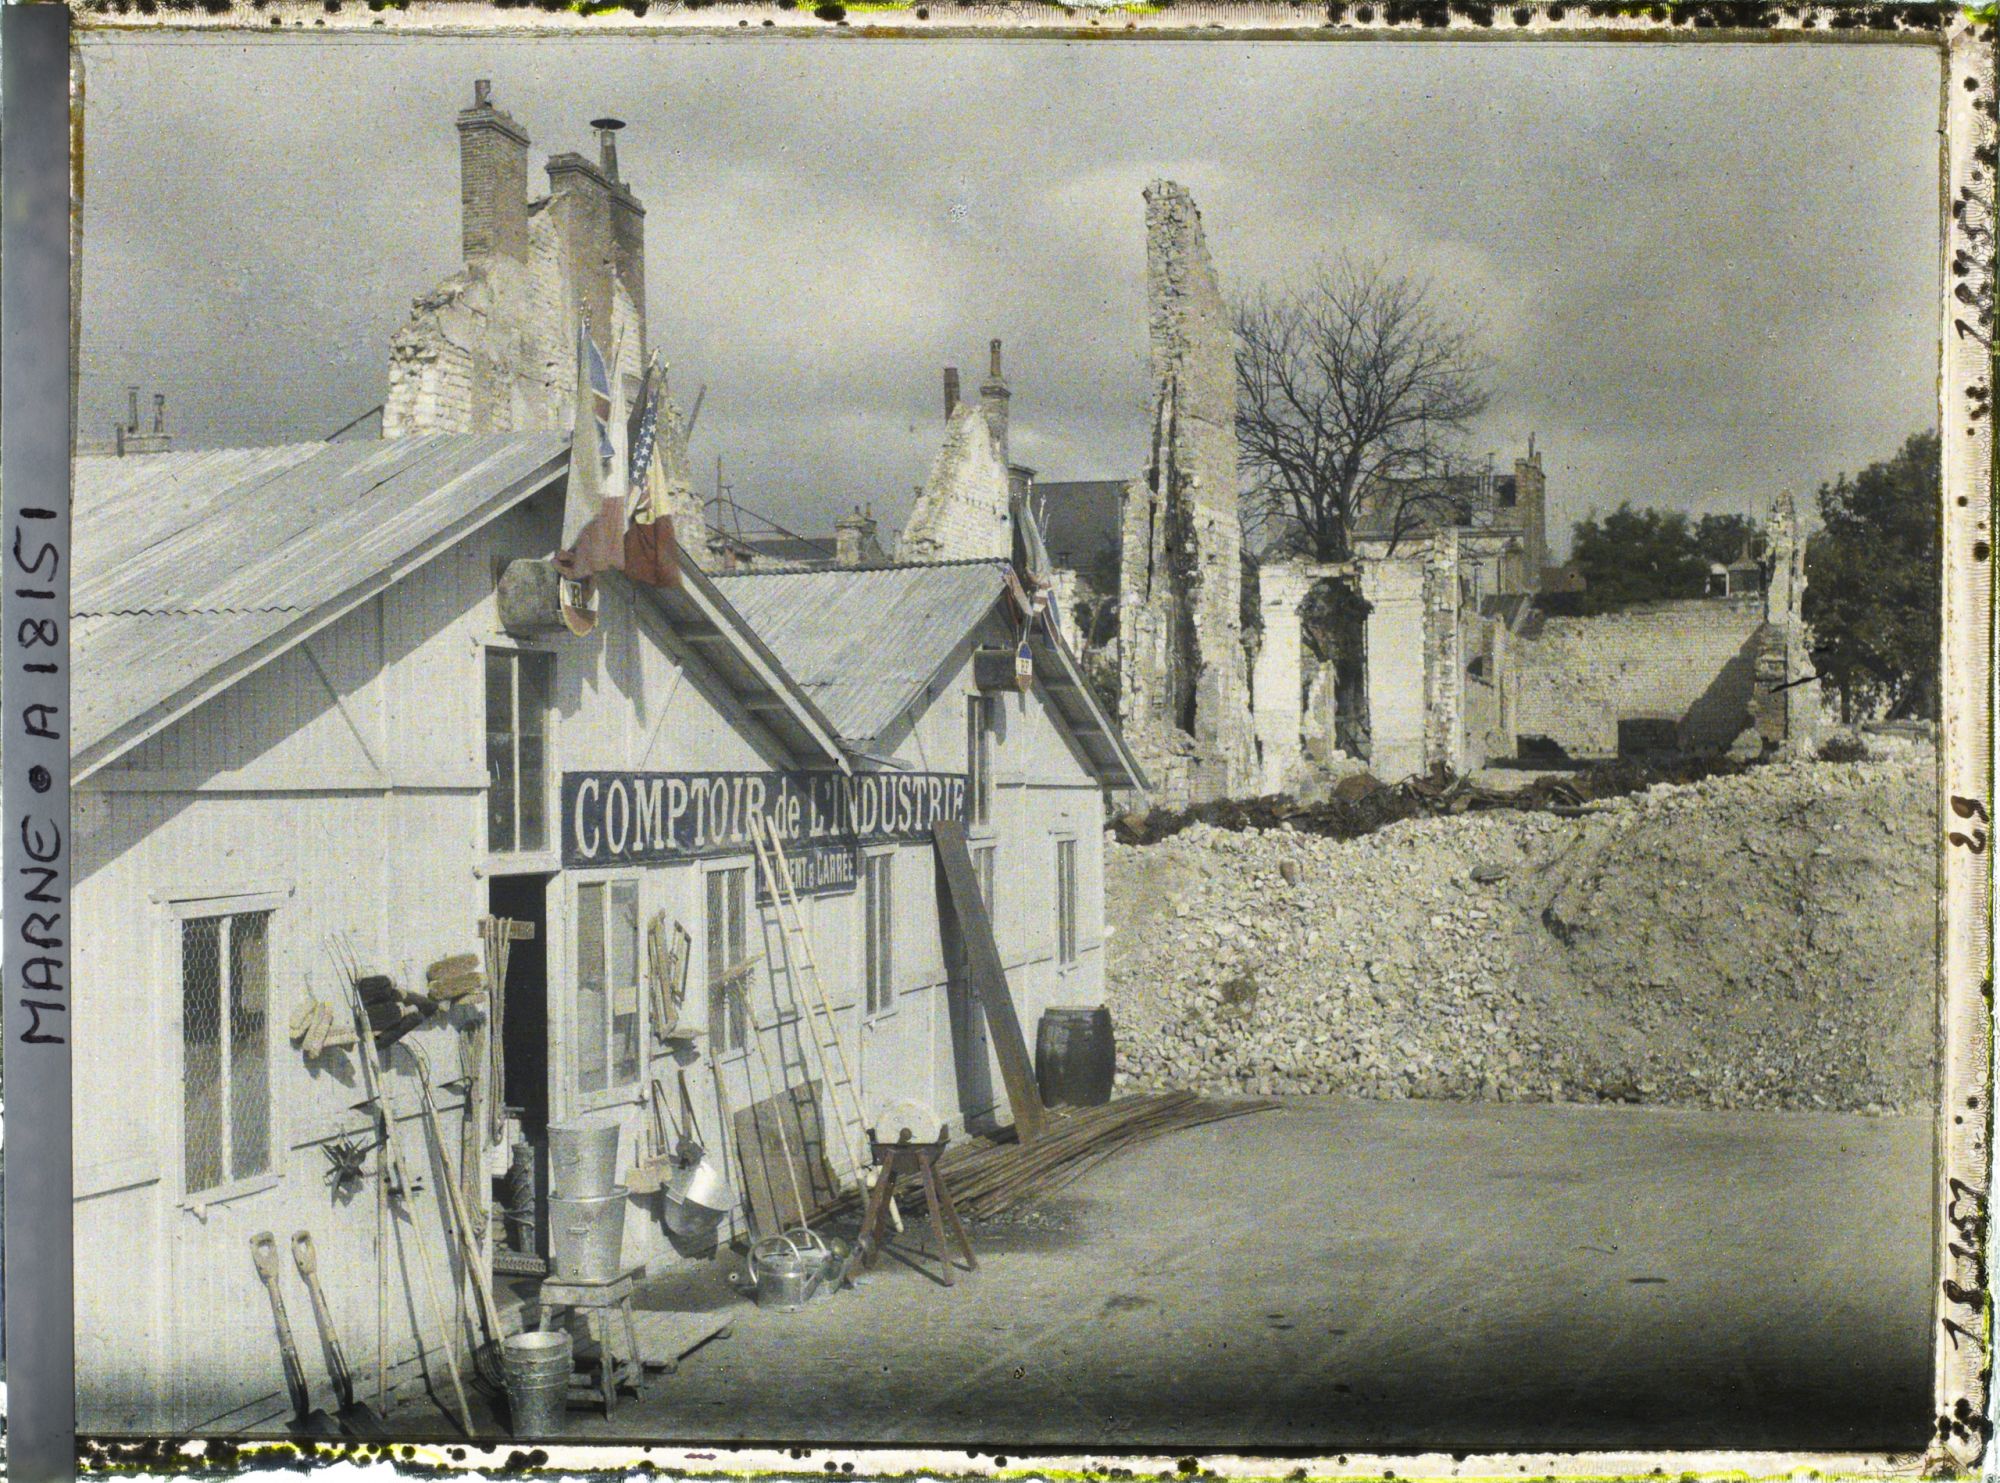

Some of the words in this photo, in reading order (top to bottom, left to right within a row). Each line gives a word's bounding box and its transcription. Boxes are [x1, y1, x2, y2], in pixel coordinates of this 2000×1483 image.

[14, 508, 60, 673] 18151
[576, 778, 766, 857] COMPTOIR
[776, 777, 799, 839] de
[810, 773, 965, 837] L'INDUSTRIE
[21, 815, 65, 1044] MARNE
